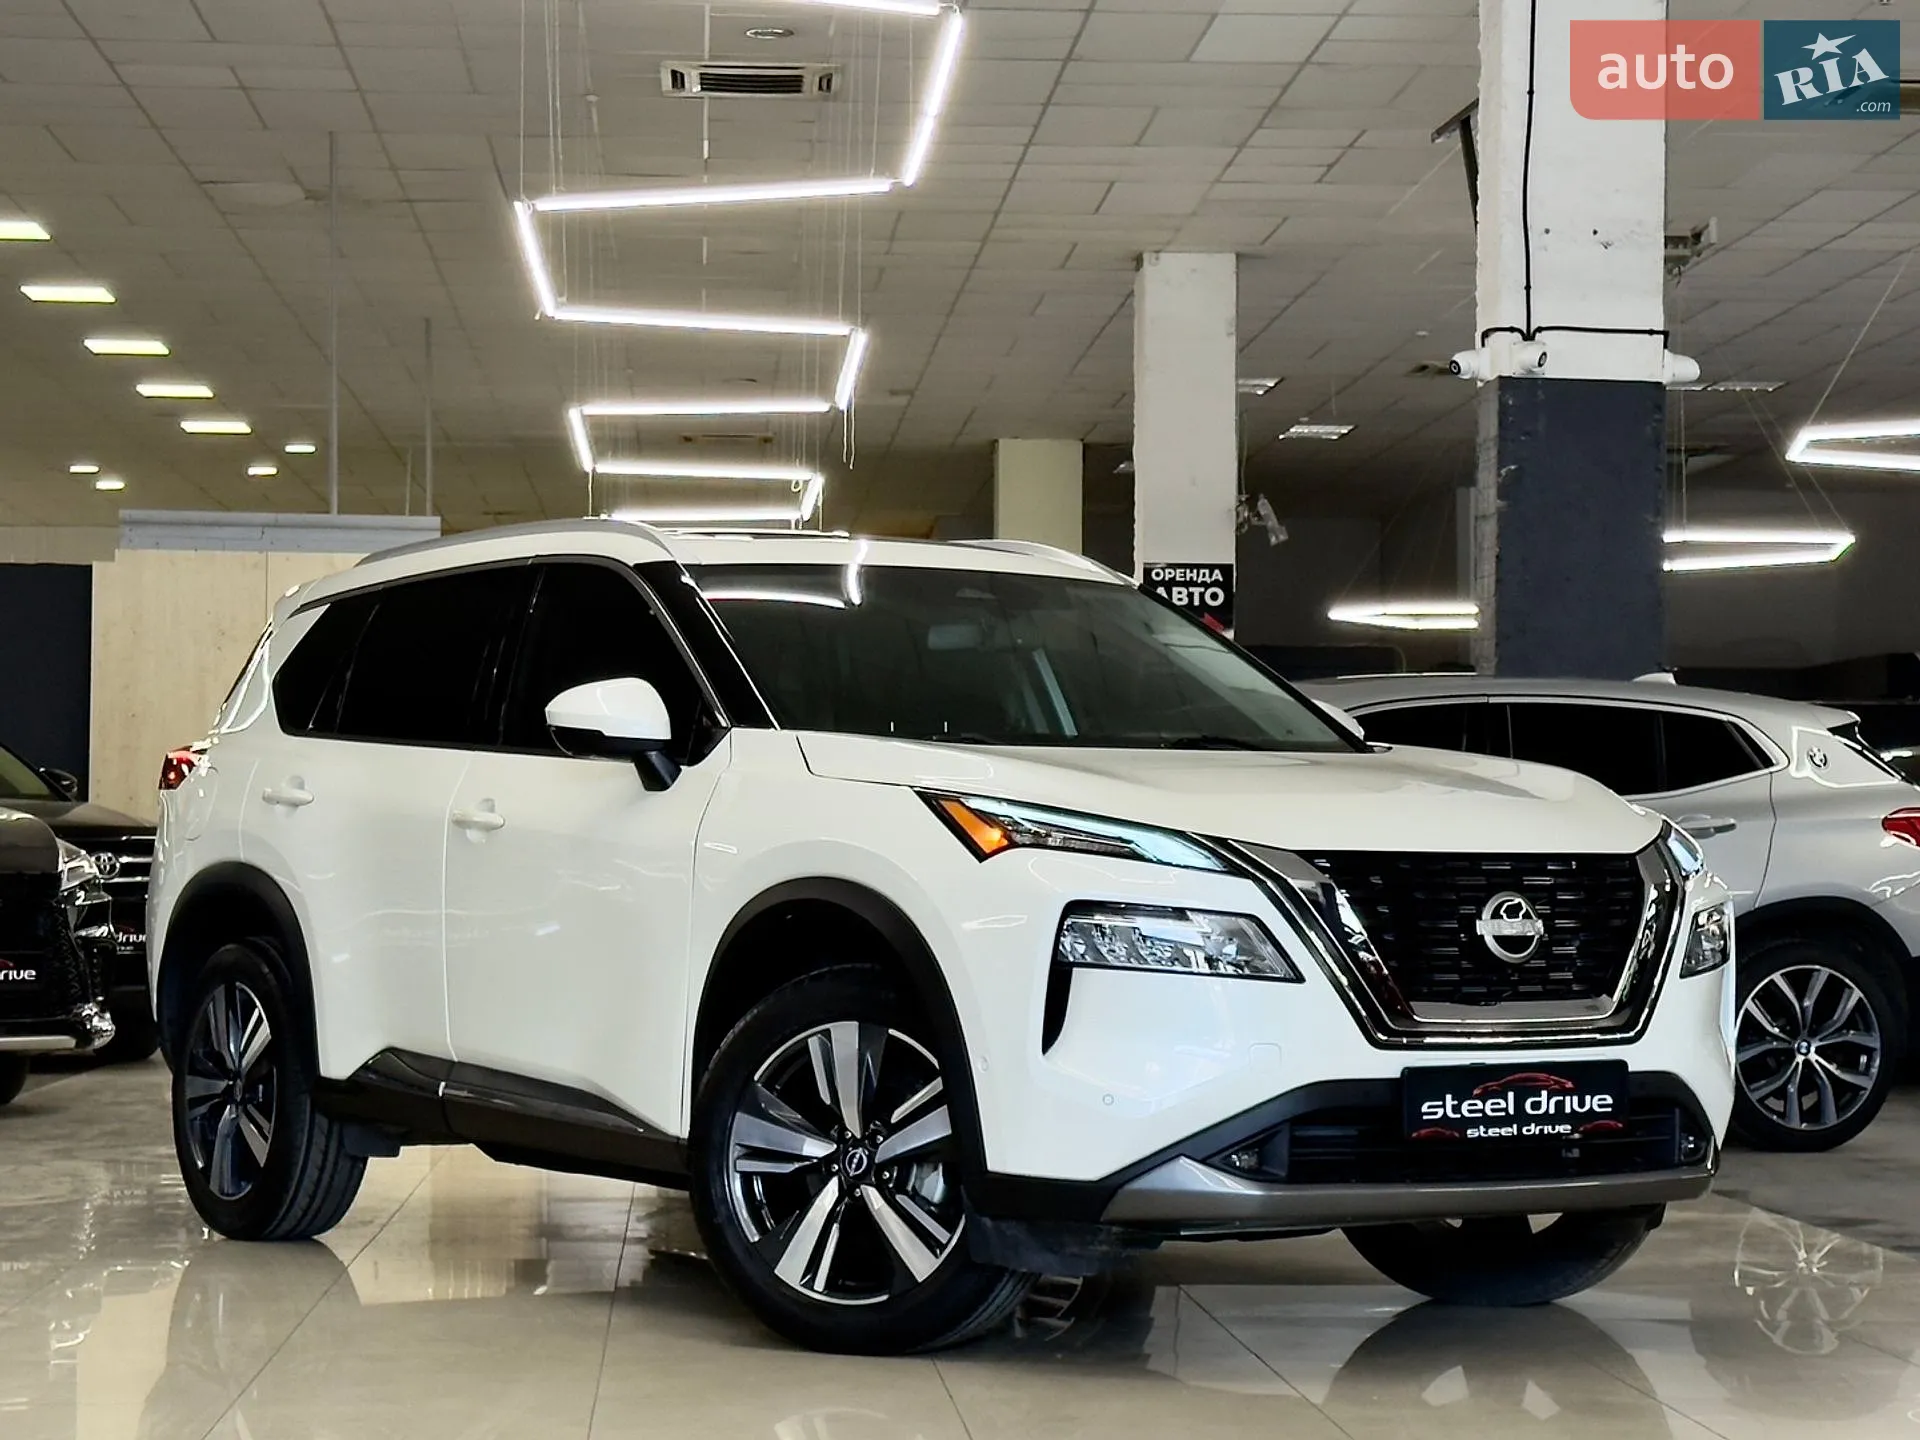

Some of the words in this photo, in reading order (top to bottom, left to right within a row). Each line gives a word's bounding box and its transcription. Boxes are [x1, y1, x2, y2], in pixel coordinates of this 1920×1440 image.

[1151, 568, 1223, 583] ОРЕНДА
[0, 968, 37, 981] rive
[1421, 1091, 1515, 1120] steel
[1524, 1090, 1614, 1115] drive
[1466, 1124, 1518, 1138] steel
[1522, 1123, 1572, 1135] drive
